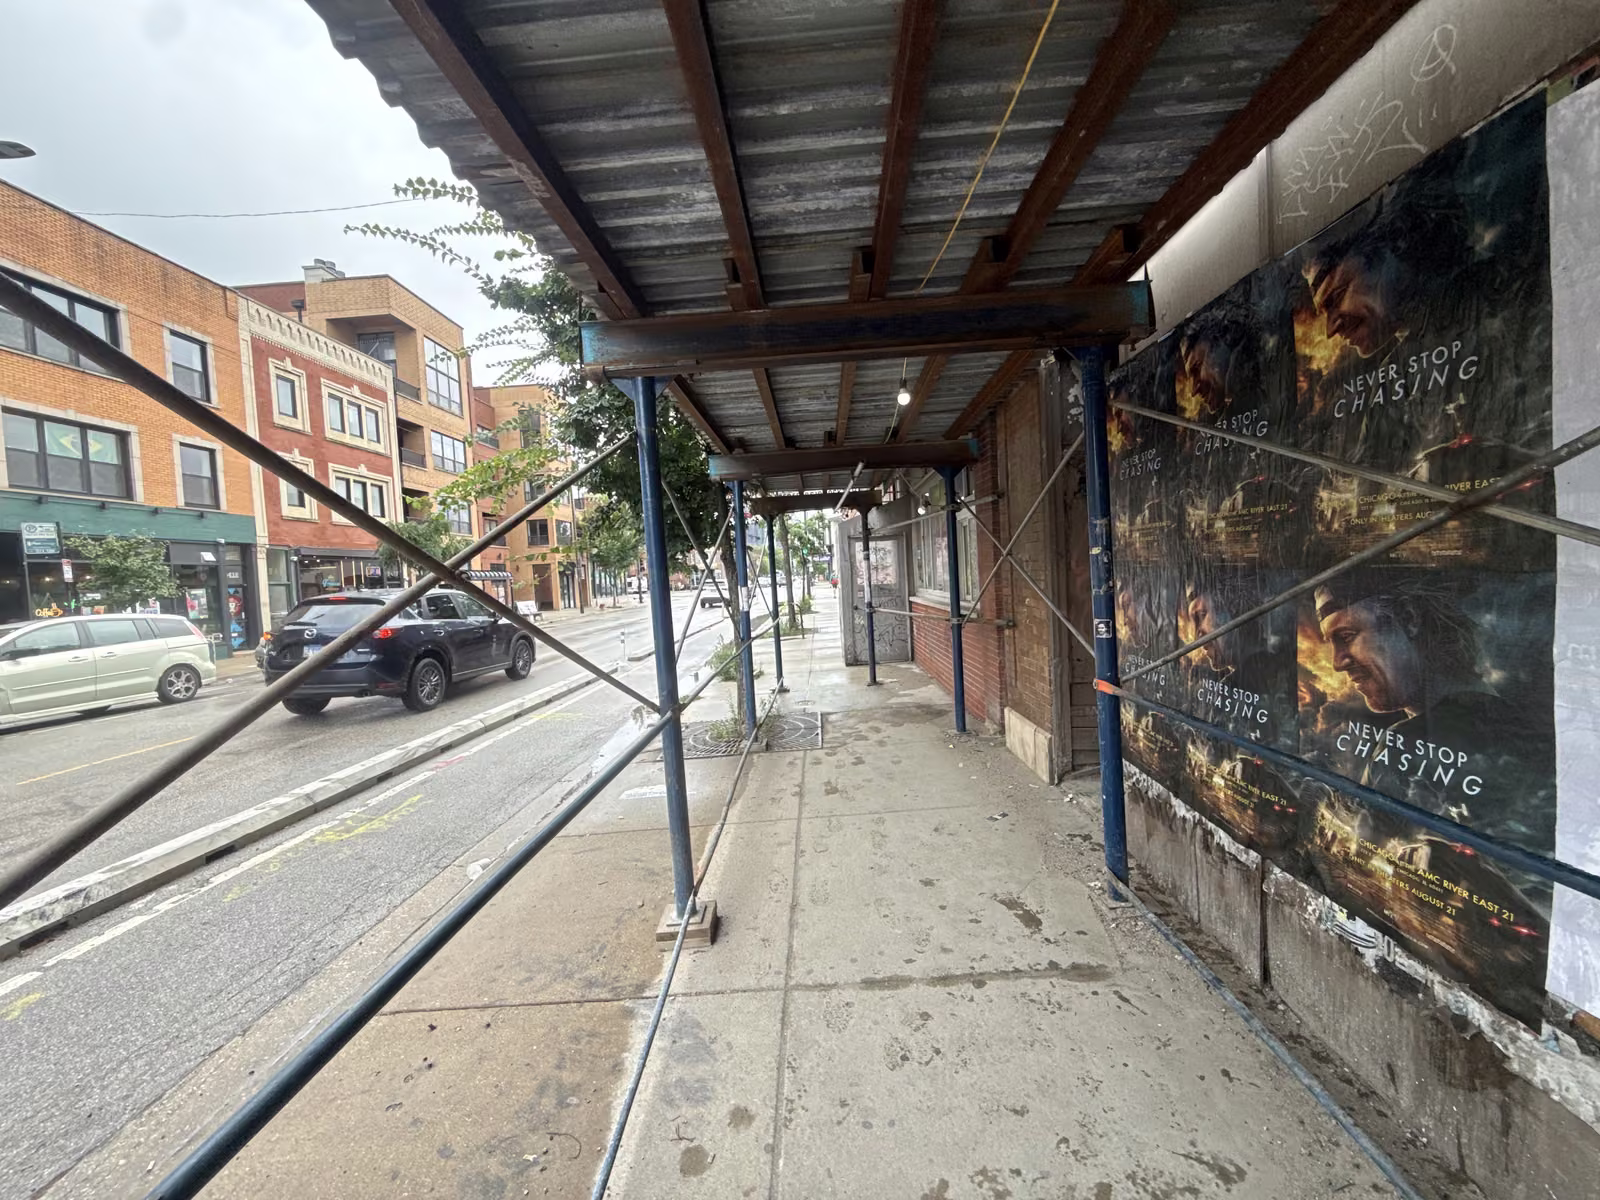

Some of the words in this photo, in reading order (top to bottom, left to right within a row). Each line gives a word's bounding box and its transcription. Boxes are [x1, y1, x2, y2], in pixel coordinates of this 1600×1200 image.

[1343, 364, 1398, 395] NEVER
[1408, 341, 1462, 373] STOP
[1334, 356, 1478, 418] CHASING
[1231, 409, 1258, 429] STOP
[1195, 420, 1269, 456] CHASNG
[1197, 688, 1269, 723] CHASING
[1202, 678, 1229, 696] NEVER
[1232, 688, 1260, 705] STOP
[1348, 720, 1405, 750] NEVER
[1415, 739, 1468, 768] STOP
[1336, 734, 1483, 795] CHASING
[1261, 791, 1279, 802] EAST
[1359, 838, 1395, 861] CHICAGO
[1417, 868, 1441, 885] AMC
[1442, 879, 1469, 900] RIVER
[1472, 894, 1500, 914] EAST
[1501, 909, 1514, 922] 21
[1411, 887, 1445, 909] AUGUST
[1446, 905, 1456, 916] 21
